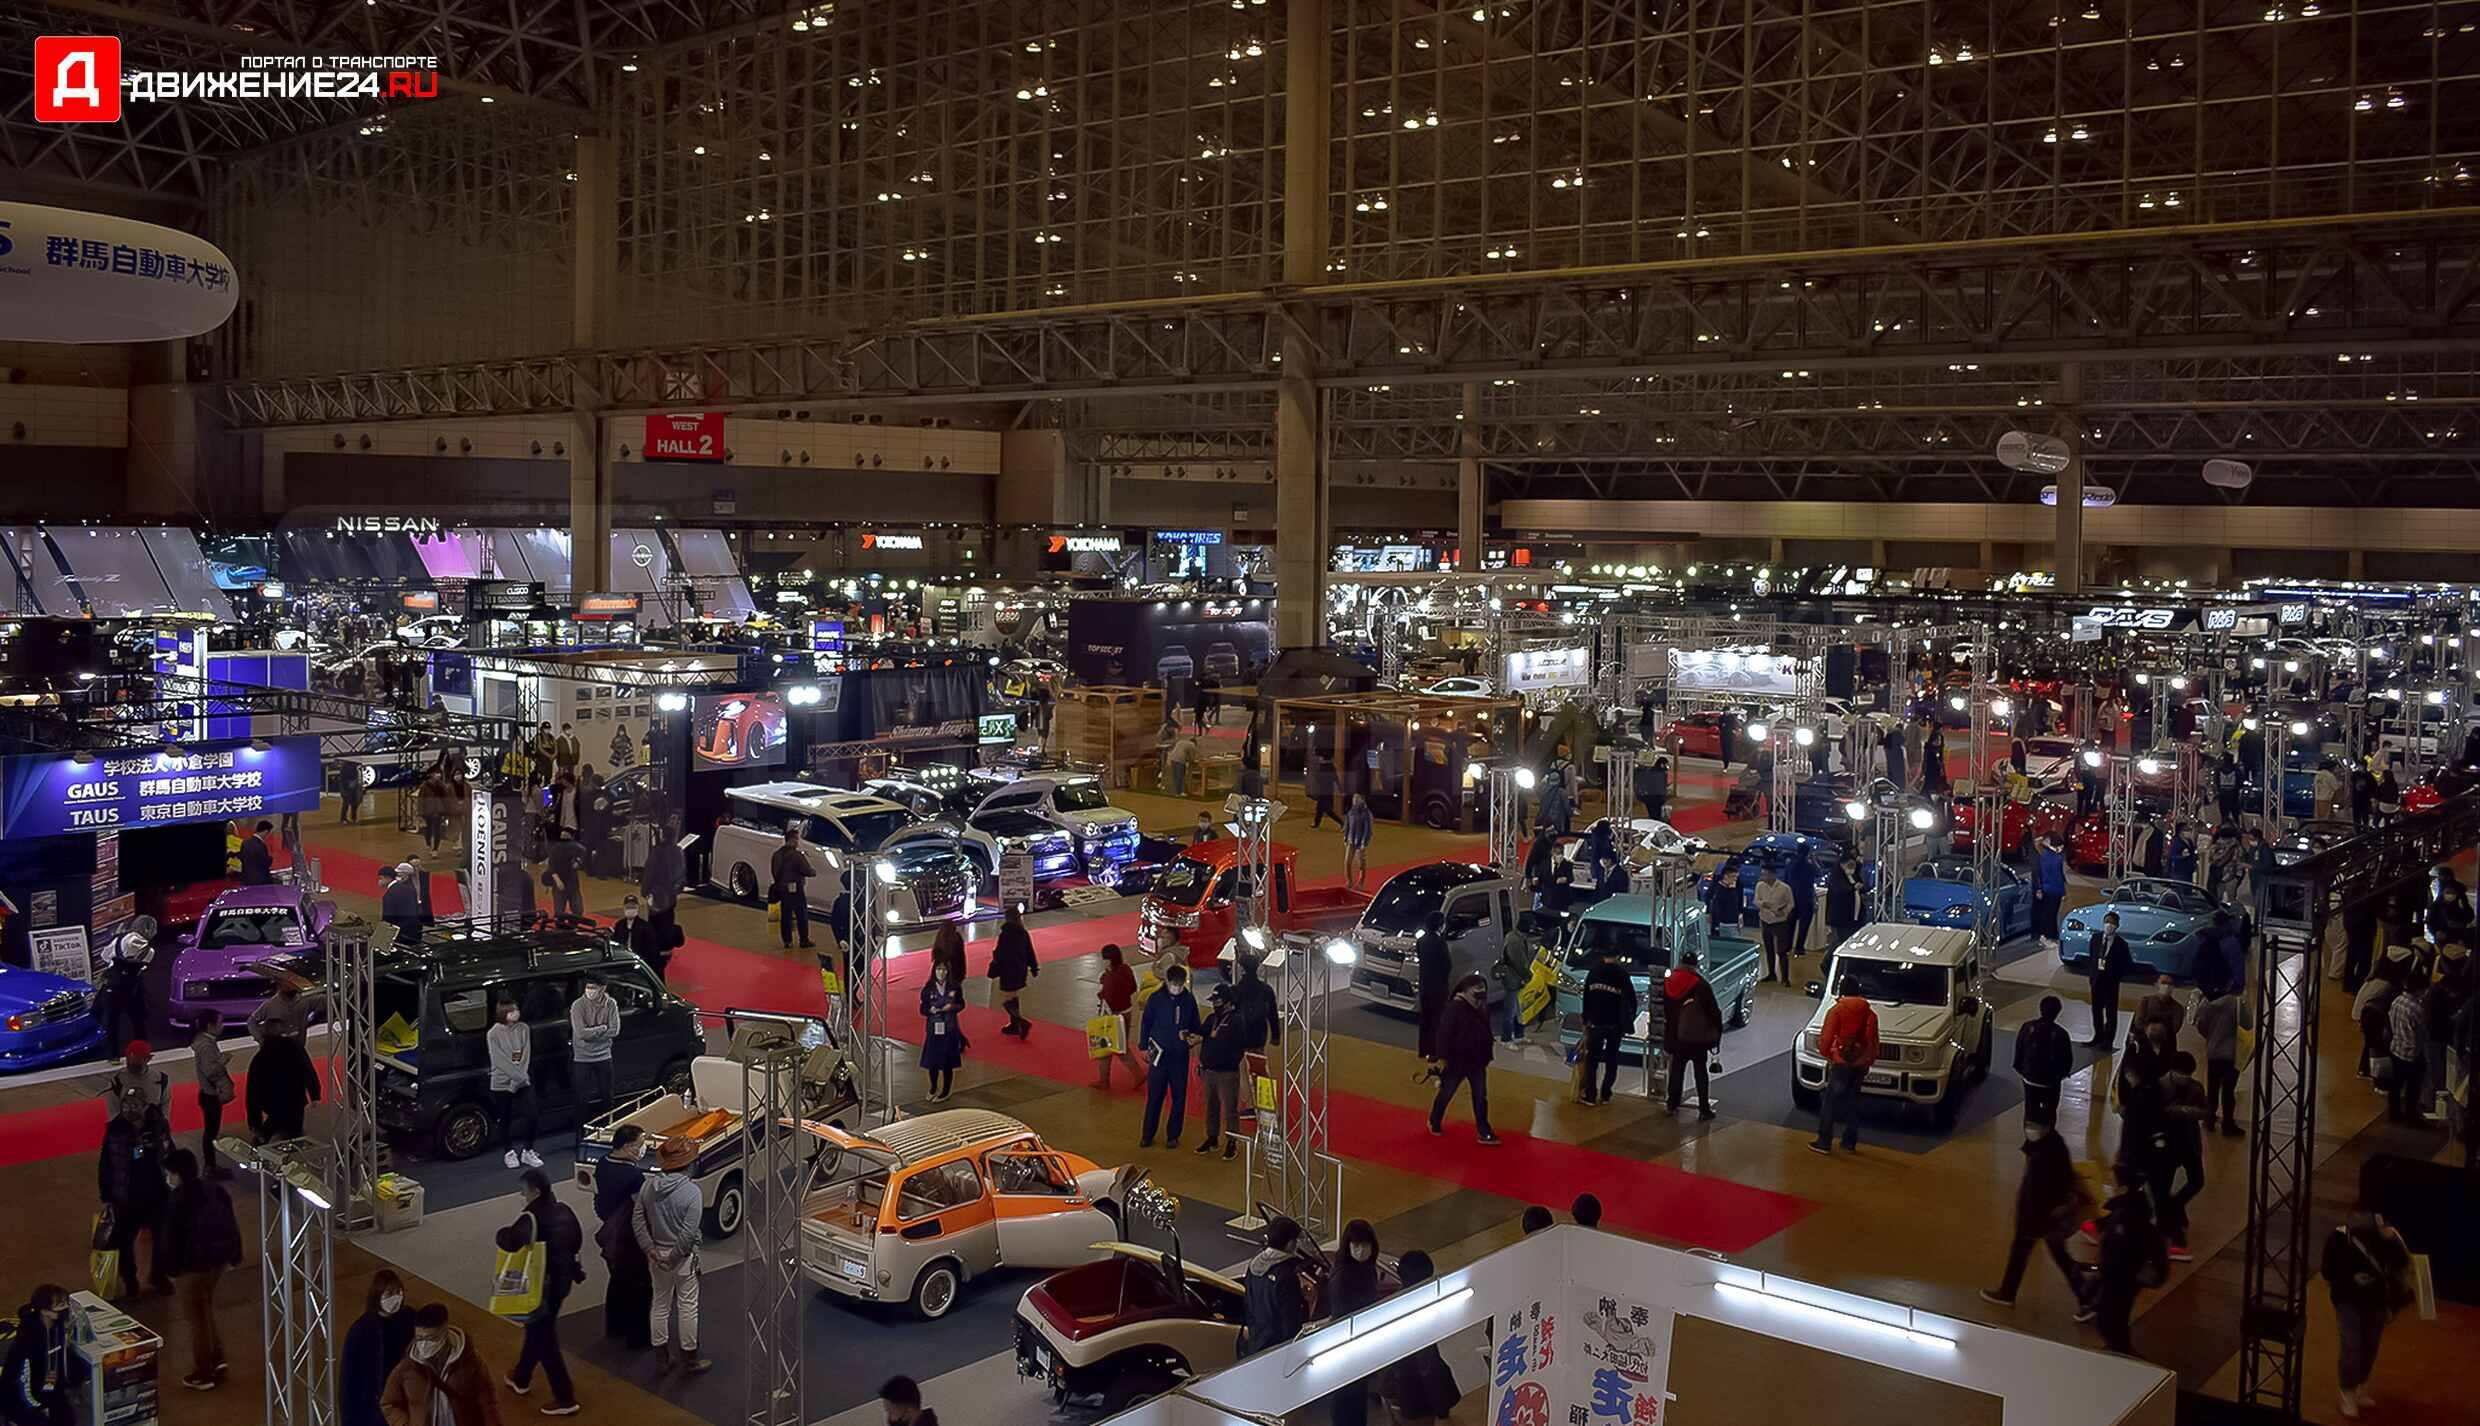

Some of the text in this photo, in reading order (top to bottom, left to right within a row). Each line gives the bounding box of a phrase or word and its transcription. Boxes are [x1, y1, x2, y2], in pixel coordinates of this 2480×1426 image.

[672, 422, 699, 431] WEST
[657, 434, 713, 455] HALL 2
[337, 516, 437, 531] NISSAN
[67, 771, 263, 799] GAUS 群馬自動車大学校
[69, 795, 263, 826] TAUS 東京自動車大学校
[492, 802, 508, 865] GAUS
